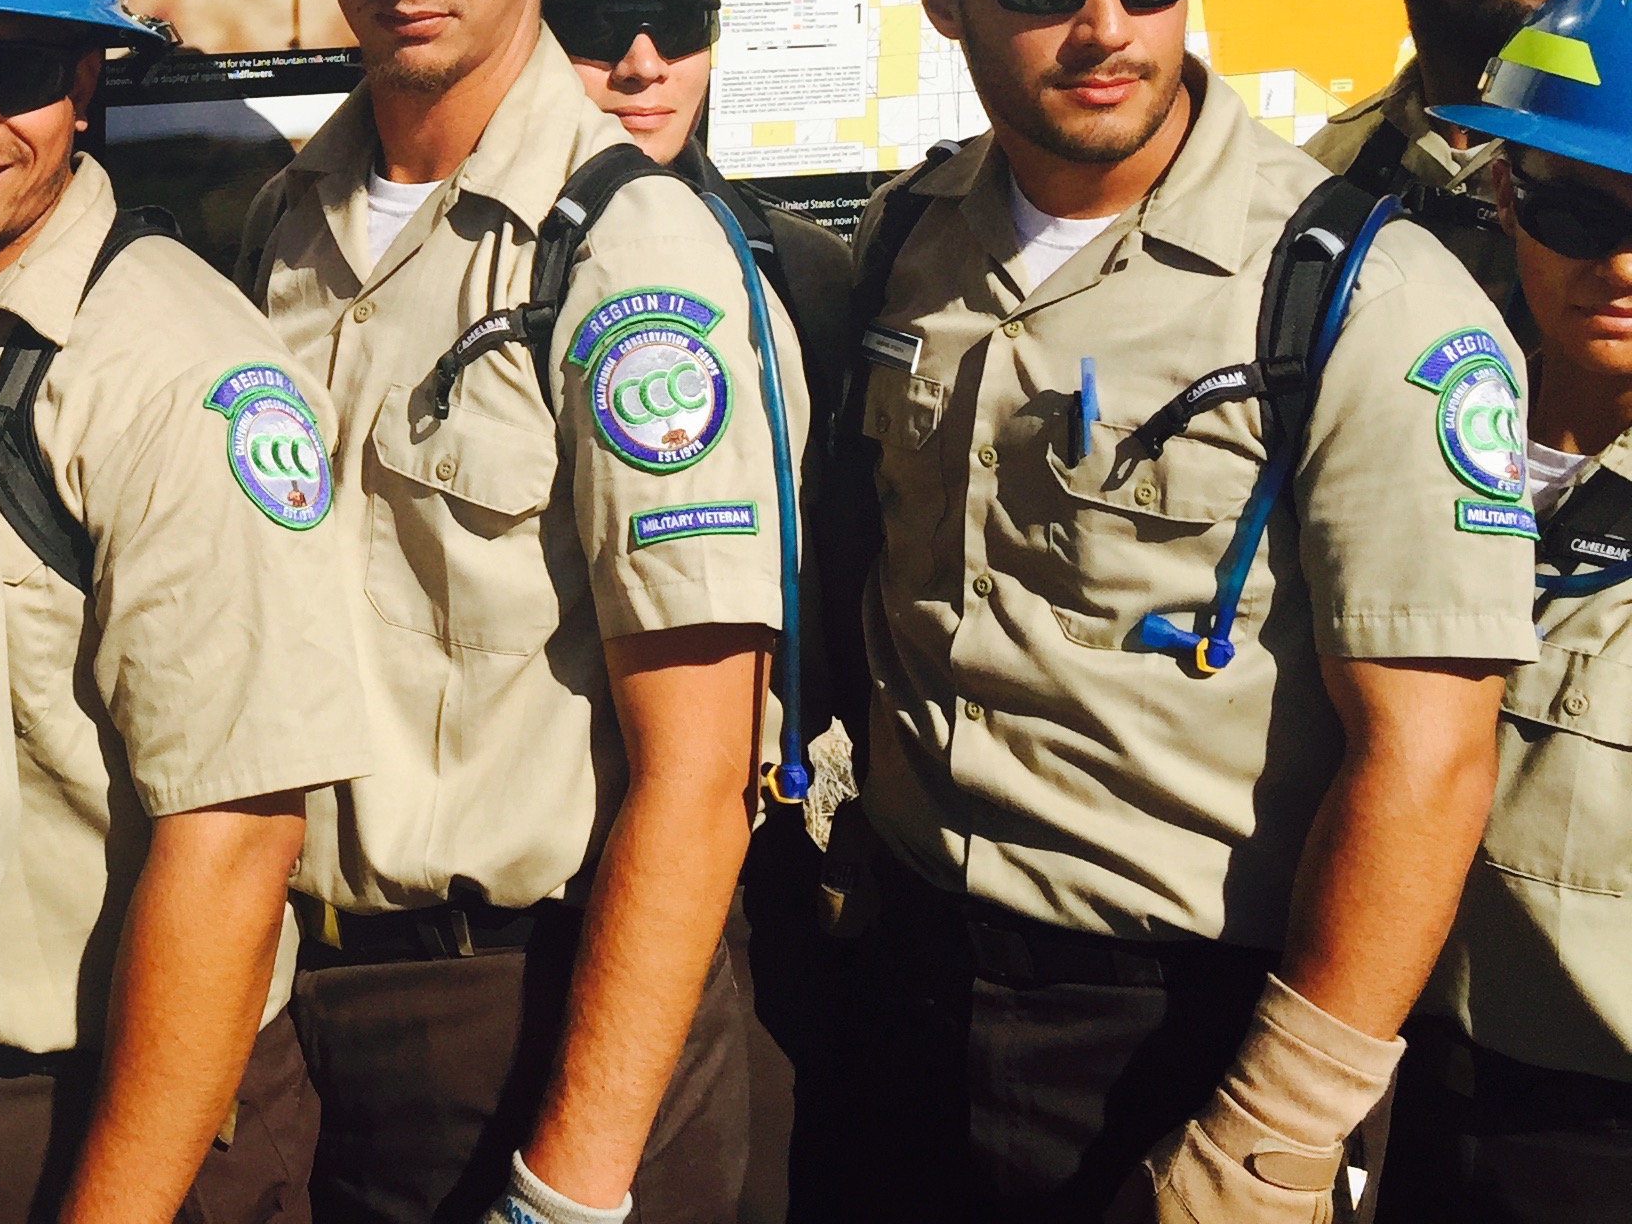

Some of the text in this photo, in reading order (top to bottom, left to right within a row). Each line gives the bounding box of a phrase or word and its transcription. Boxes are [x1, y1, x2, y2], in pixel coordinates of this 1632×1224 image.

[854, 3, 862, 24] 1
[810, 198, 835, 209] States
[834, 217, 852, 226] now
[590, 294, 659, 336] REGION
[456, 316, 510, 354] CAMELBAK
[618, 330, 690, 355] CONSERVATION
[694, 347, 720, 376] CORPS
[230, 370, 284, 393] REGION
[596, 355, 617, 411] CALIFORNIA
[613, 361, 707, 425] CCC
[1186, 371, 1247, 403] CAMELBAK
[250, 433, 319, 481] CCC
[641, 508, 750, 534] MILITARY VETERAN
[1467, 508, 1518, 525] MILITARY
[1570, 538, 1631, 562] CAMELBAK
